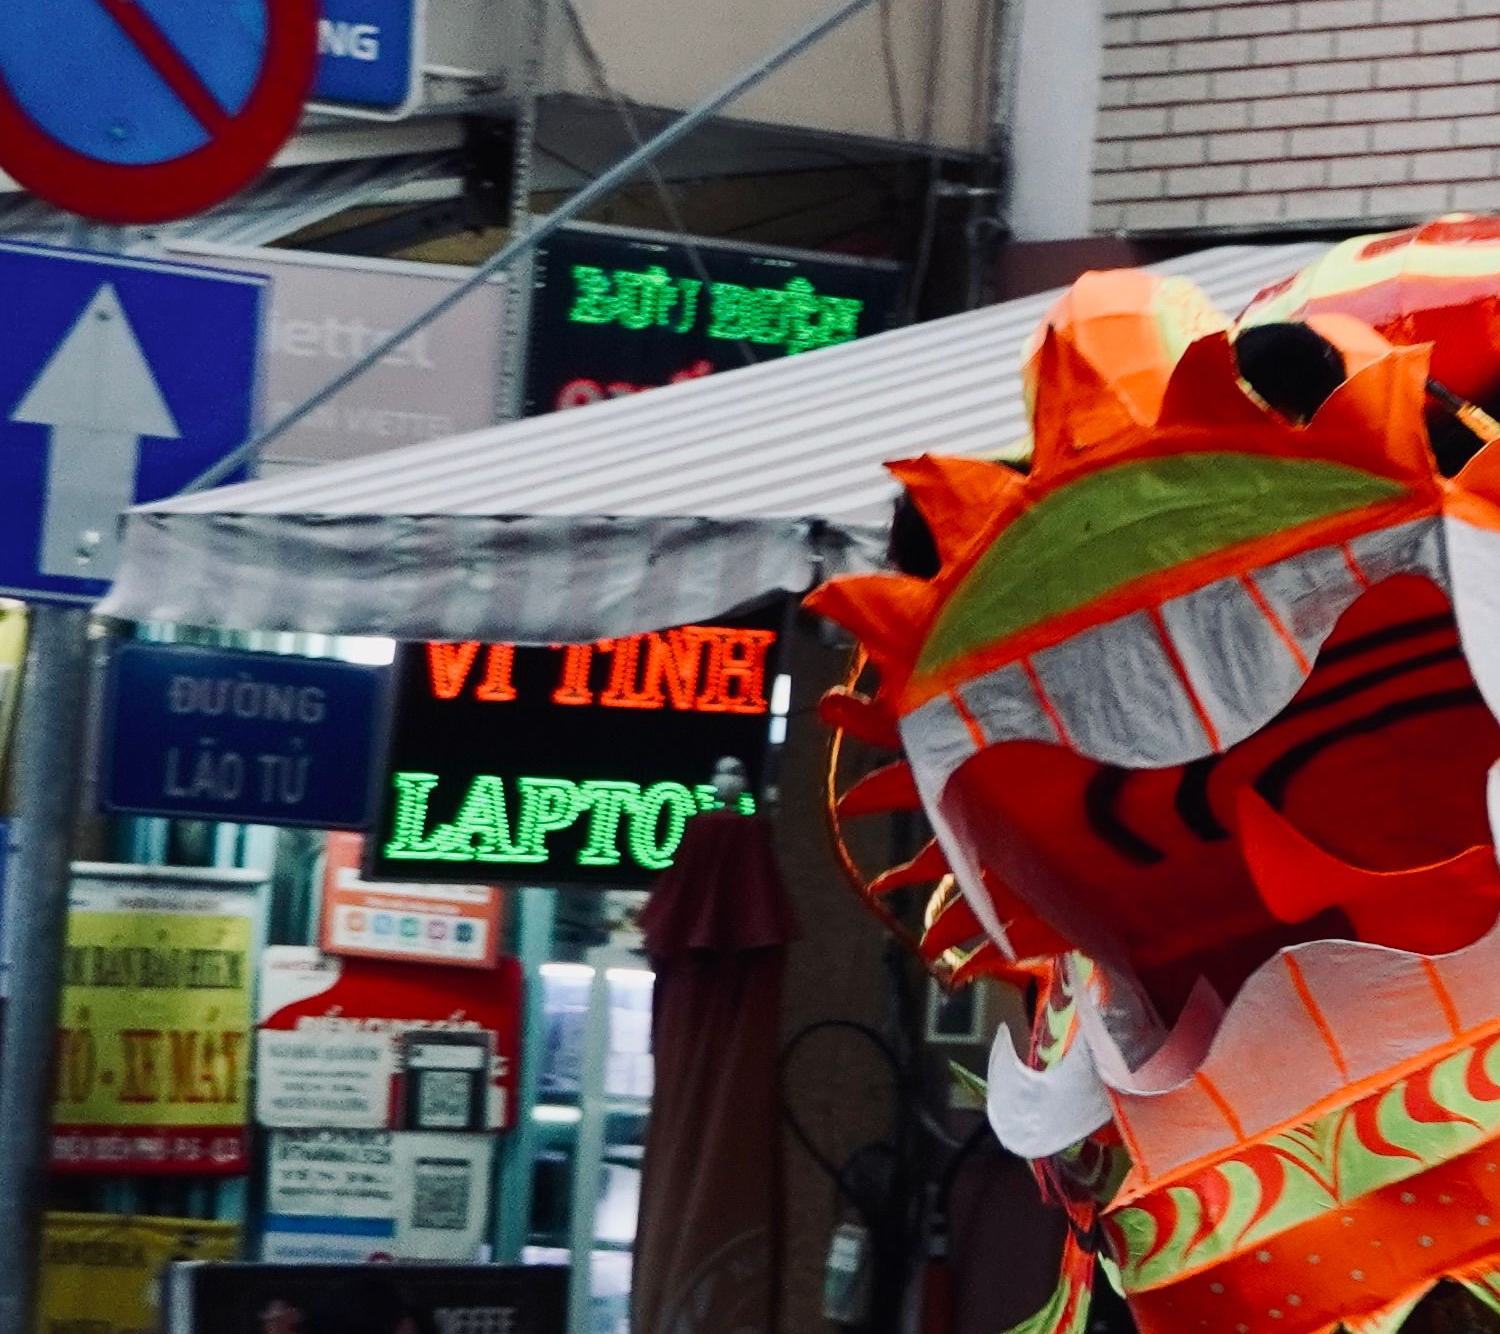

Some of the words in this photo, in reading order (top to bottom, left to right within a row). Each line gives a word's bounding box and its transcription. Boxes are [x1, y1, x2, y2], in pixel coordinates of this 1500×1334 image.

[167, 670, 327, 724] ĐƯỜNG
[427, 637, 518, 703] VI
[163, 736, 246, 801] LÃO
[256, 735, 318, 805] TỬ
[384, 770, 757, 870] LAPTO
